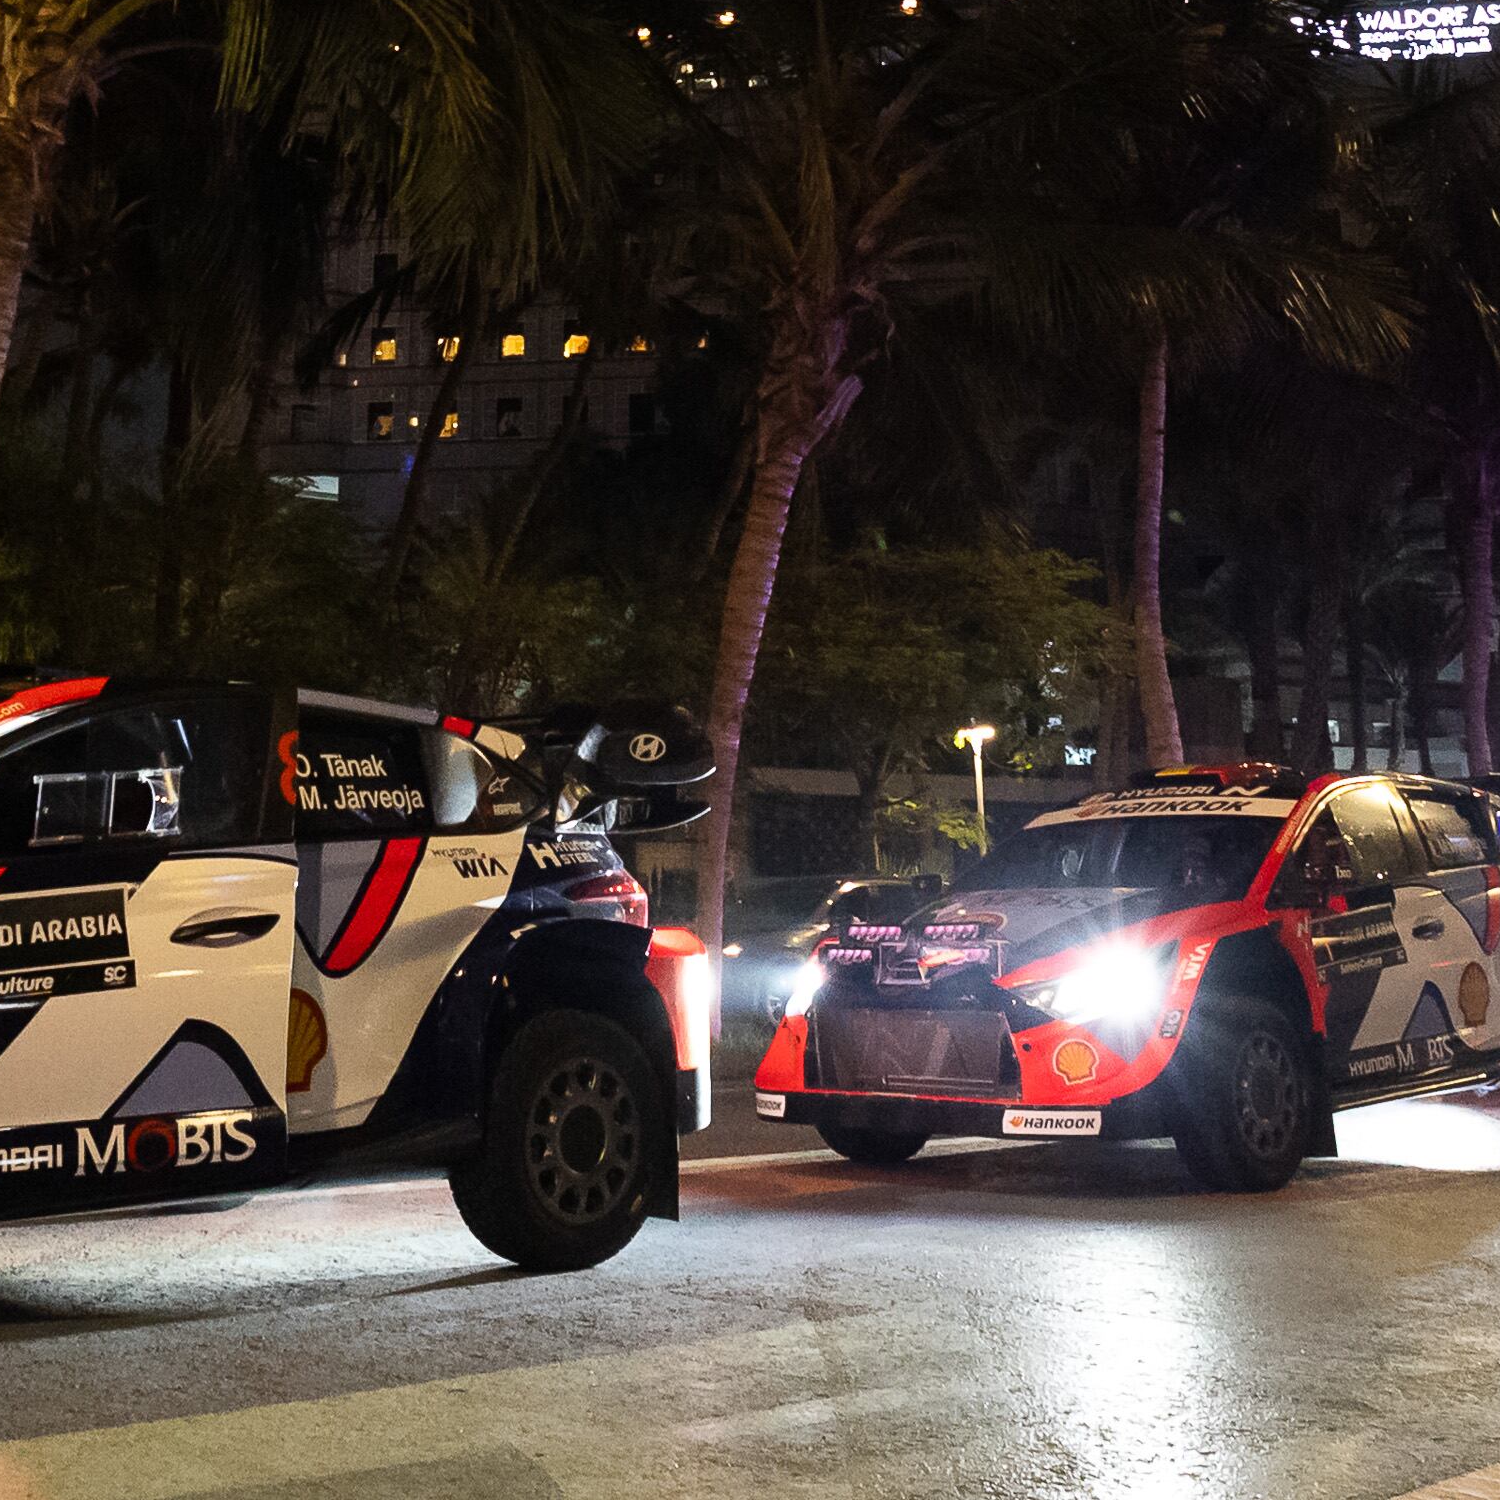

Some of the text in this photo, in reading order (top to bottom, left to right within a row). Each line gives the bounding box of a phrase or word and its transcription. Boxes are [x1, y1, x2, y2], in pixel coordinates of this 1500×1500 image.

[1357, 5, 1469, 31] WALDORF
[320, 752, 388, 779] Tänak
[298, 783, 425, 815] M. Järveoja
[30, 912, 123, 944] ARABIA
[74, 1110, 257, 1178] MOBIS
